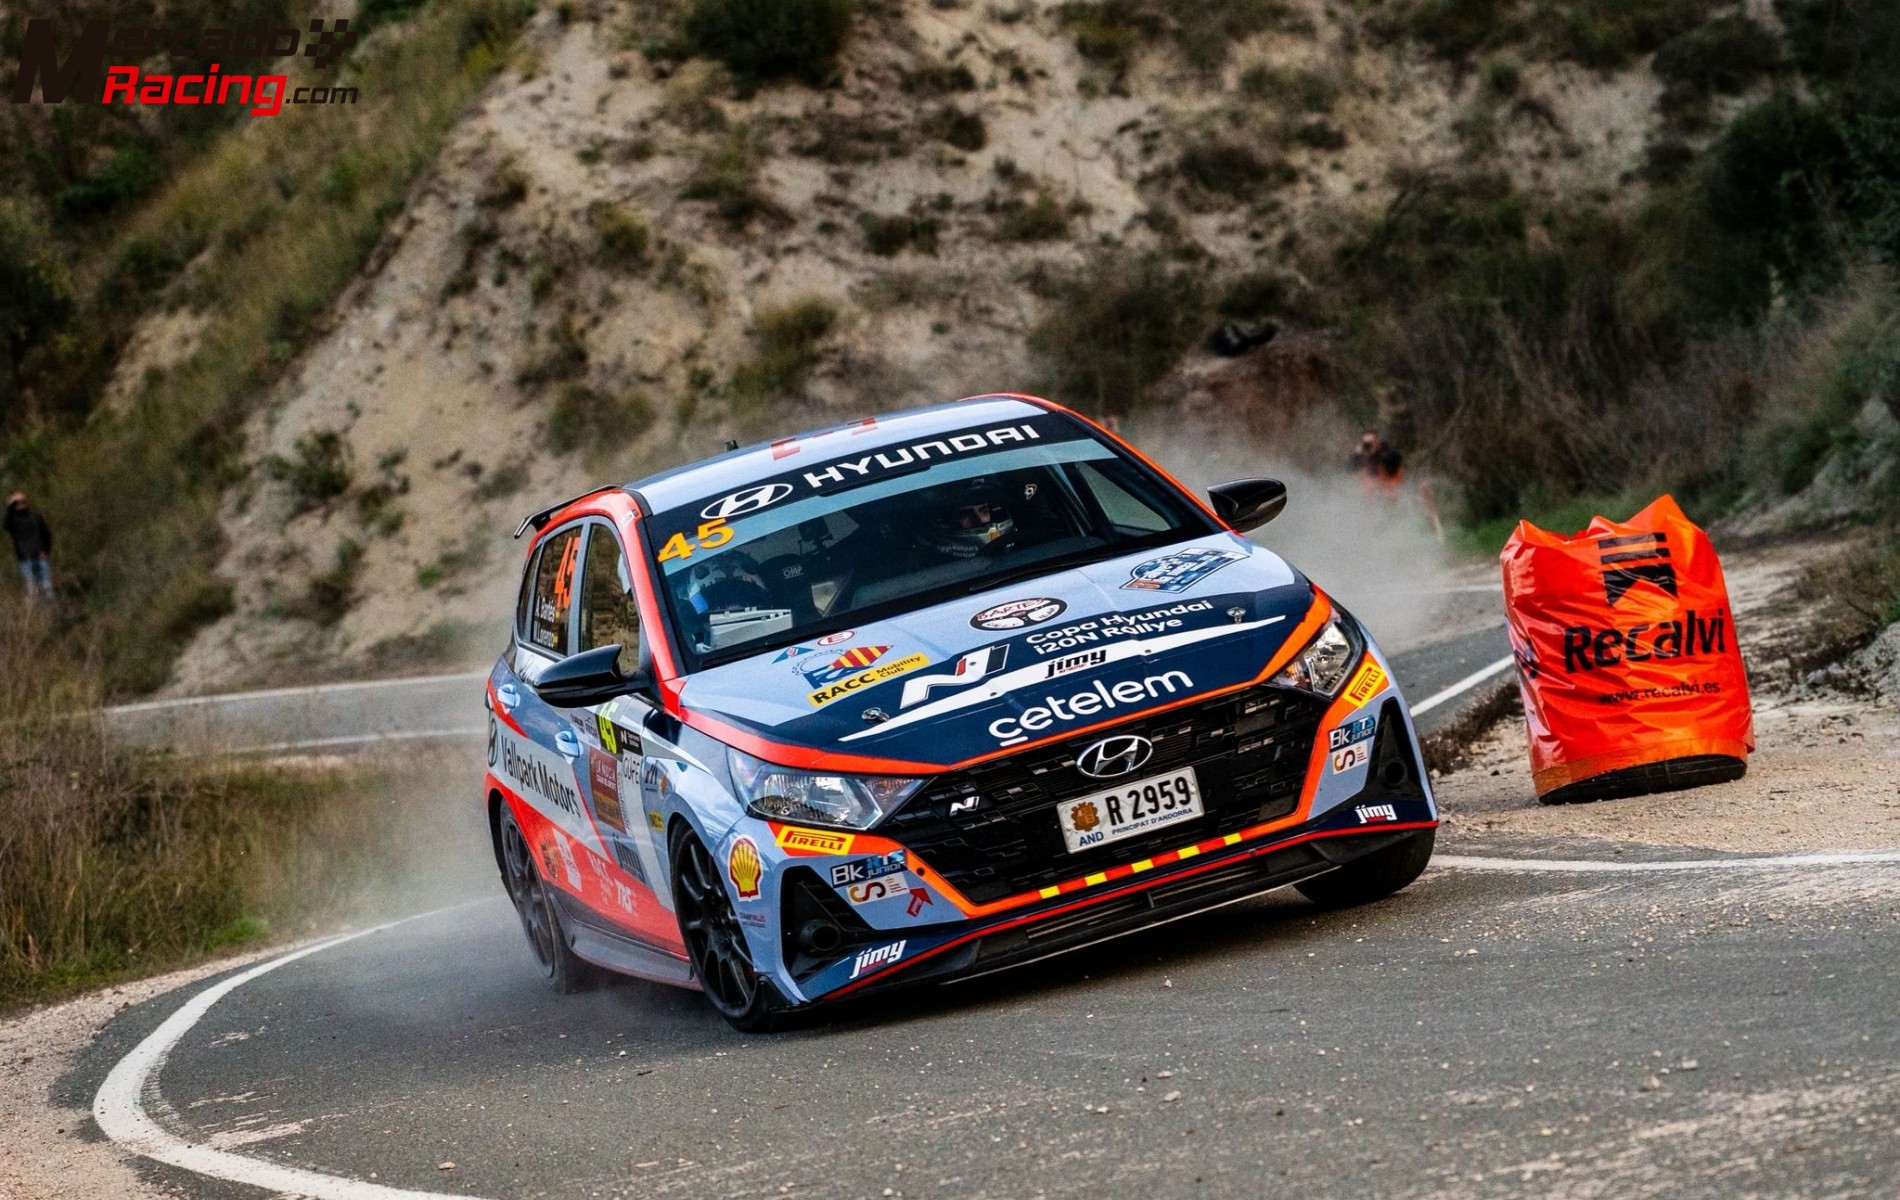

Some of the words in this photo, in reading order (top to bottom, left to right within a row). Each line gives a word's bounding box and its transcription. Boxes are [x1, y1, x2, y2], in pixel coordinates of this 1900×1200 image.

[803, 425, 1040, 488] HYUNDAI
[658, 518, 735, 563] 45
[554, 536, 580, 609] 45
[1026, 620, 1099, 645] Copa
[1100, 600, 1214, 628] Hyundai
[1033, 631, 1100, 655] i20N
[1100, 618, 1183, 639] Rallye
[1564, 608, 1725, 673] Recalvi
[876, 656, 920, 675] Mobility
[879, 667, 905, 678] Club
[1045, 649, 1106, 679] jimy
[812, 673, 875, 703] RACC
[1349, 667, 1381, 702] PIRELLI
[989, 671, 1194, 746] cetelem
[501, 735, 541, 795] Vallpark
[538, 761, 581, 818] Motors
[1105, 795, 1124, 826] R
[1127, 776, 1191, 820] 2959
[1355, 804, 1397, 824] jimy
[1079, 831, 1104, 847] AND
[1112, 820, 1149, 835] PRINCIPAT
[1151, 808, 1193, 824] D'ANDORRA
[783, 830, 846, 850] PIRELLI
[832, 864, 865, 886] Bk
[849, 940, 907, 979] jimy
